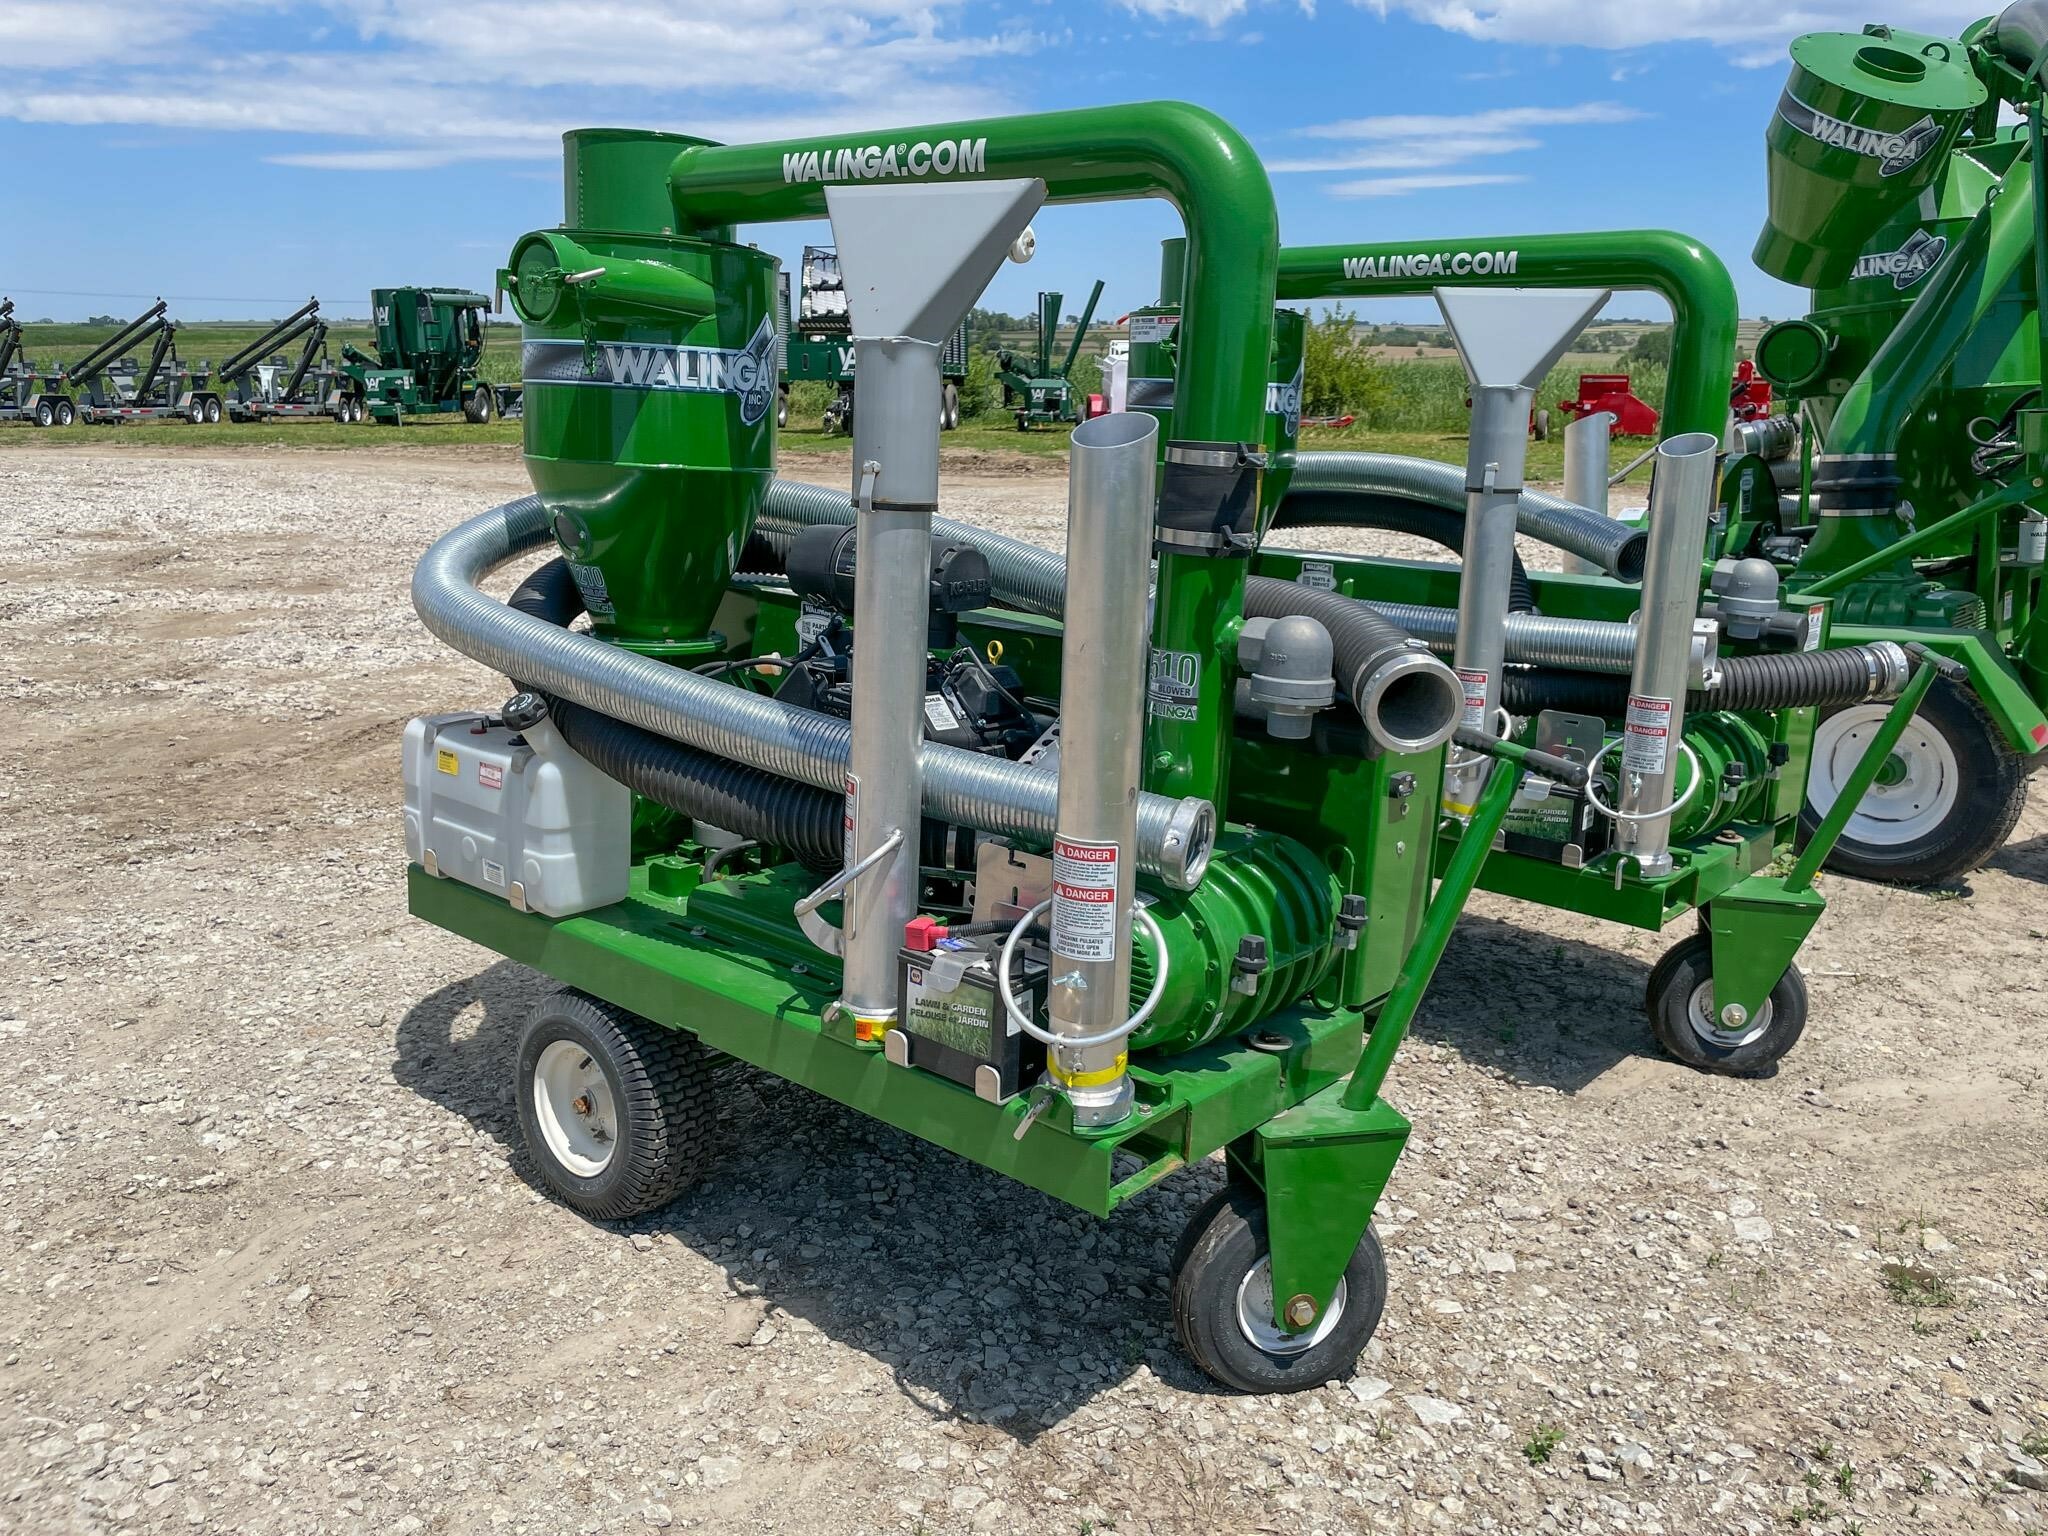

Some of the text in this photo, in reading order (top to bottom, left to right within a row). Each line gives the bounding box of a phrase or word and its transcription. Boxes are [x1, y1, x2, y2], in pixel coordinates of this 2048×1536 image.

[1812, 115, 1917, 160] WALINGA
[1850, 252, 1925, 278] ALINGA
[603, 344, 770, 393] WALINGA
[1158, 684, 1191, 696] BLOWER
[1636, 702, 1666, 710] DANGER
[1634, 727, 1663, 736] DANGER
[1067, 847, 1110, 860] DANGER
[1066, 888, 1109, 900] DANGER
[915, 997, 940, 1010] LAWN
[951, 1003, 987, 1016] GARDEN
[910, 1008, 947, 1022] PELOUSE
[958, 1016, 989, 1028] JARDIN
